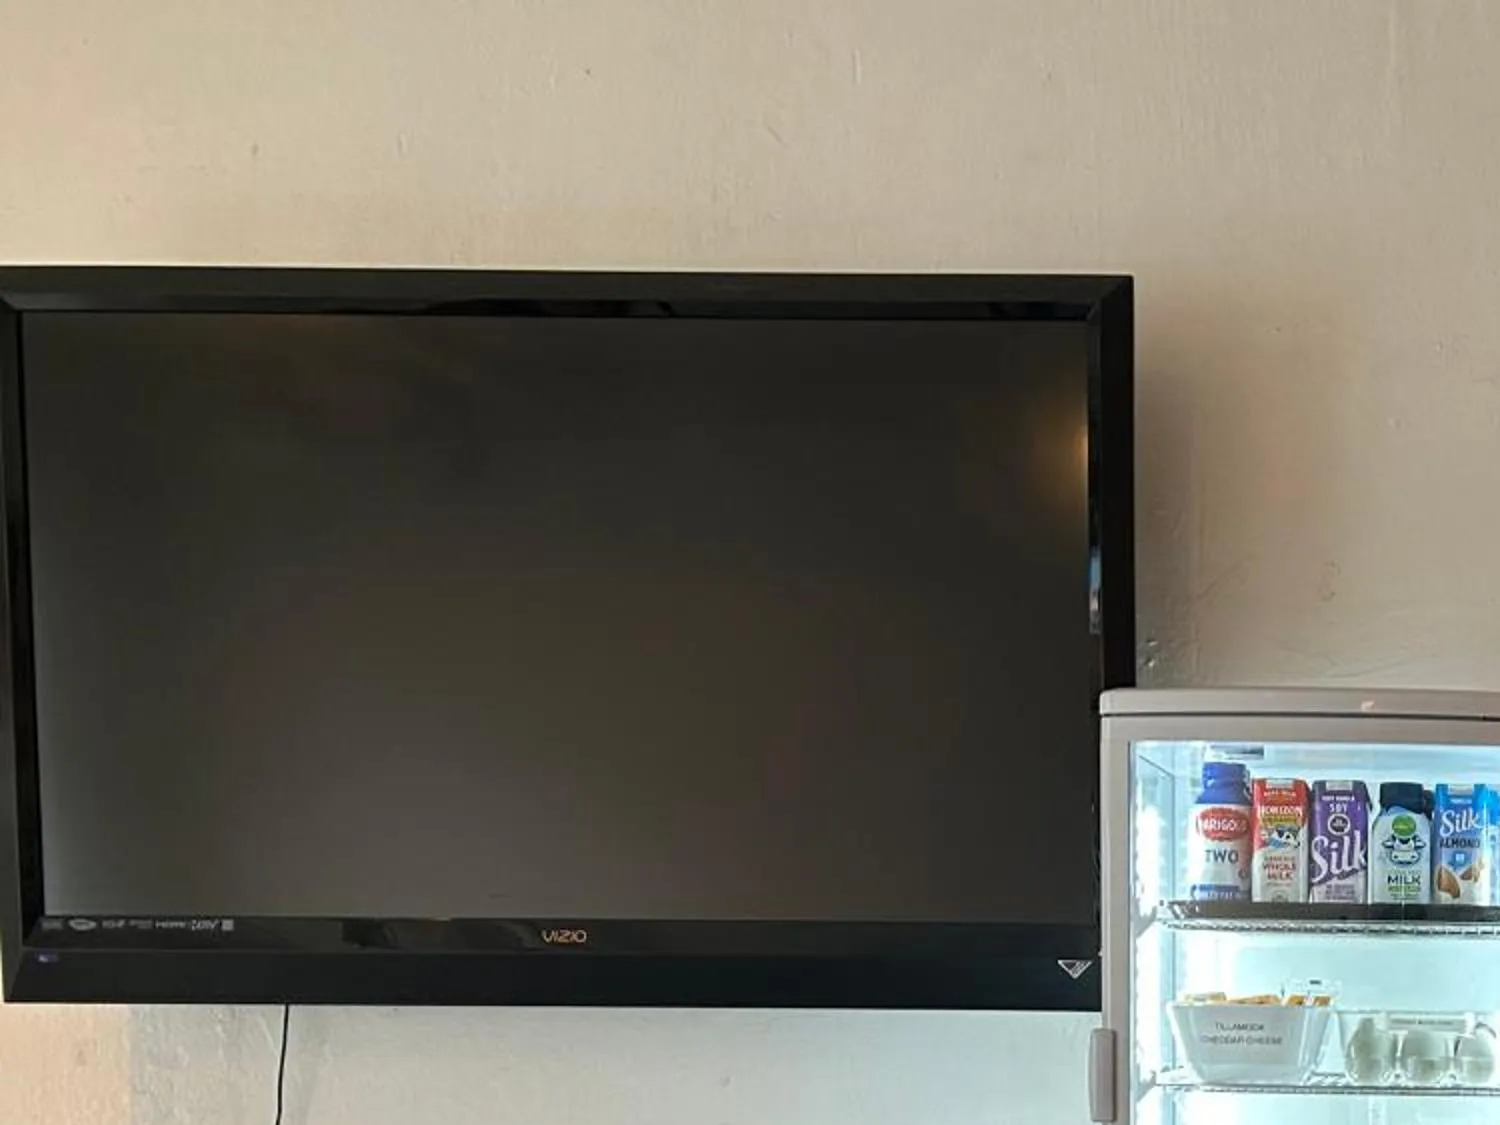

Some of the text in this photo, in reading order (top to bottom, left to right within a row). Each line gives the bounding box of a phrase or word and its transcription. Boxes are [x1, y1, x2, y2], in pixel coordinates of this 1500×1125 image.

[1440, 807, 1485, 837] Silk
[1439, 837, 1481, 849] ALMOND
[1204, 848, 1240, 865] TWO
[1311, 829, 1367, 883] Silk
[1387, 874, 1421, 885] MILK
[541, 929, 588, 943] VIZIO
